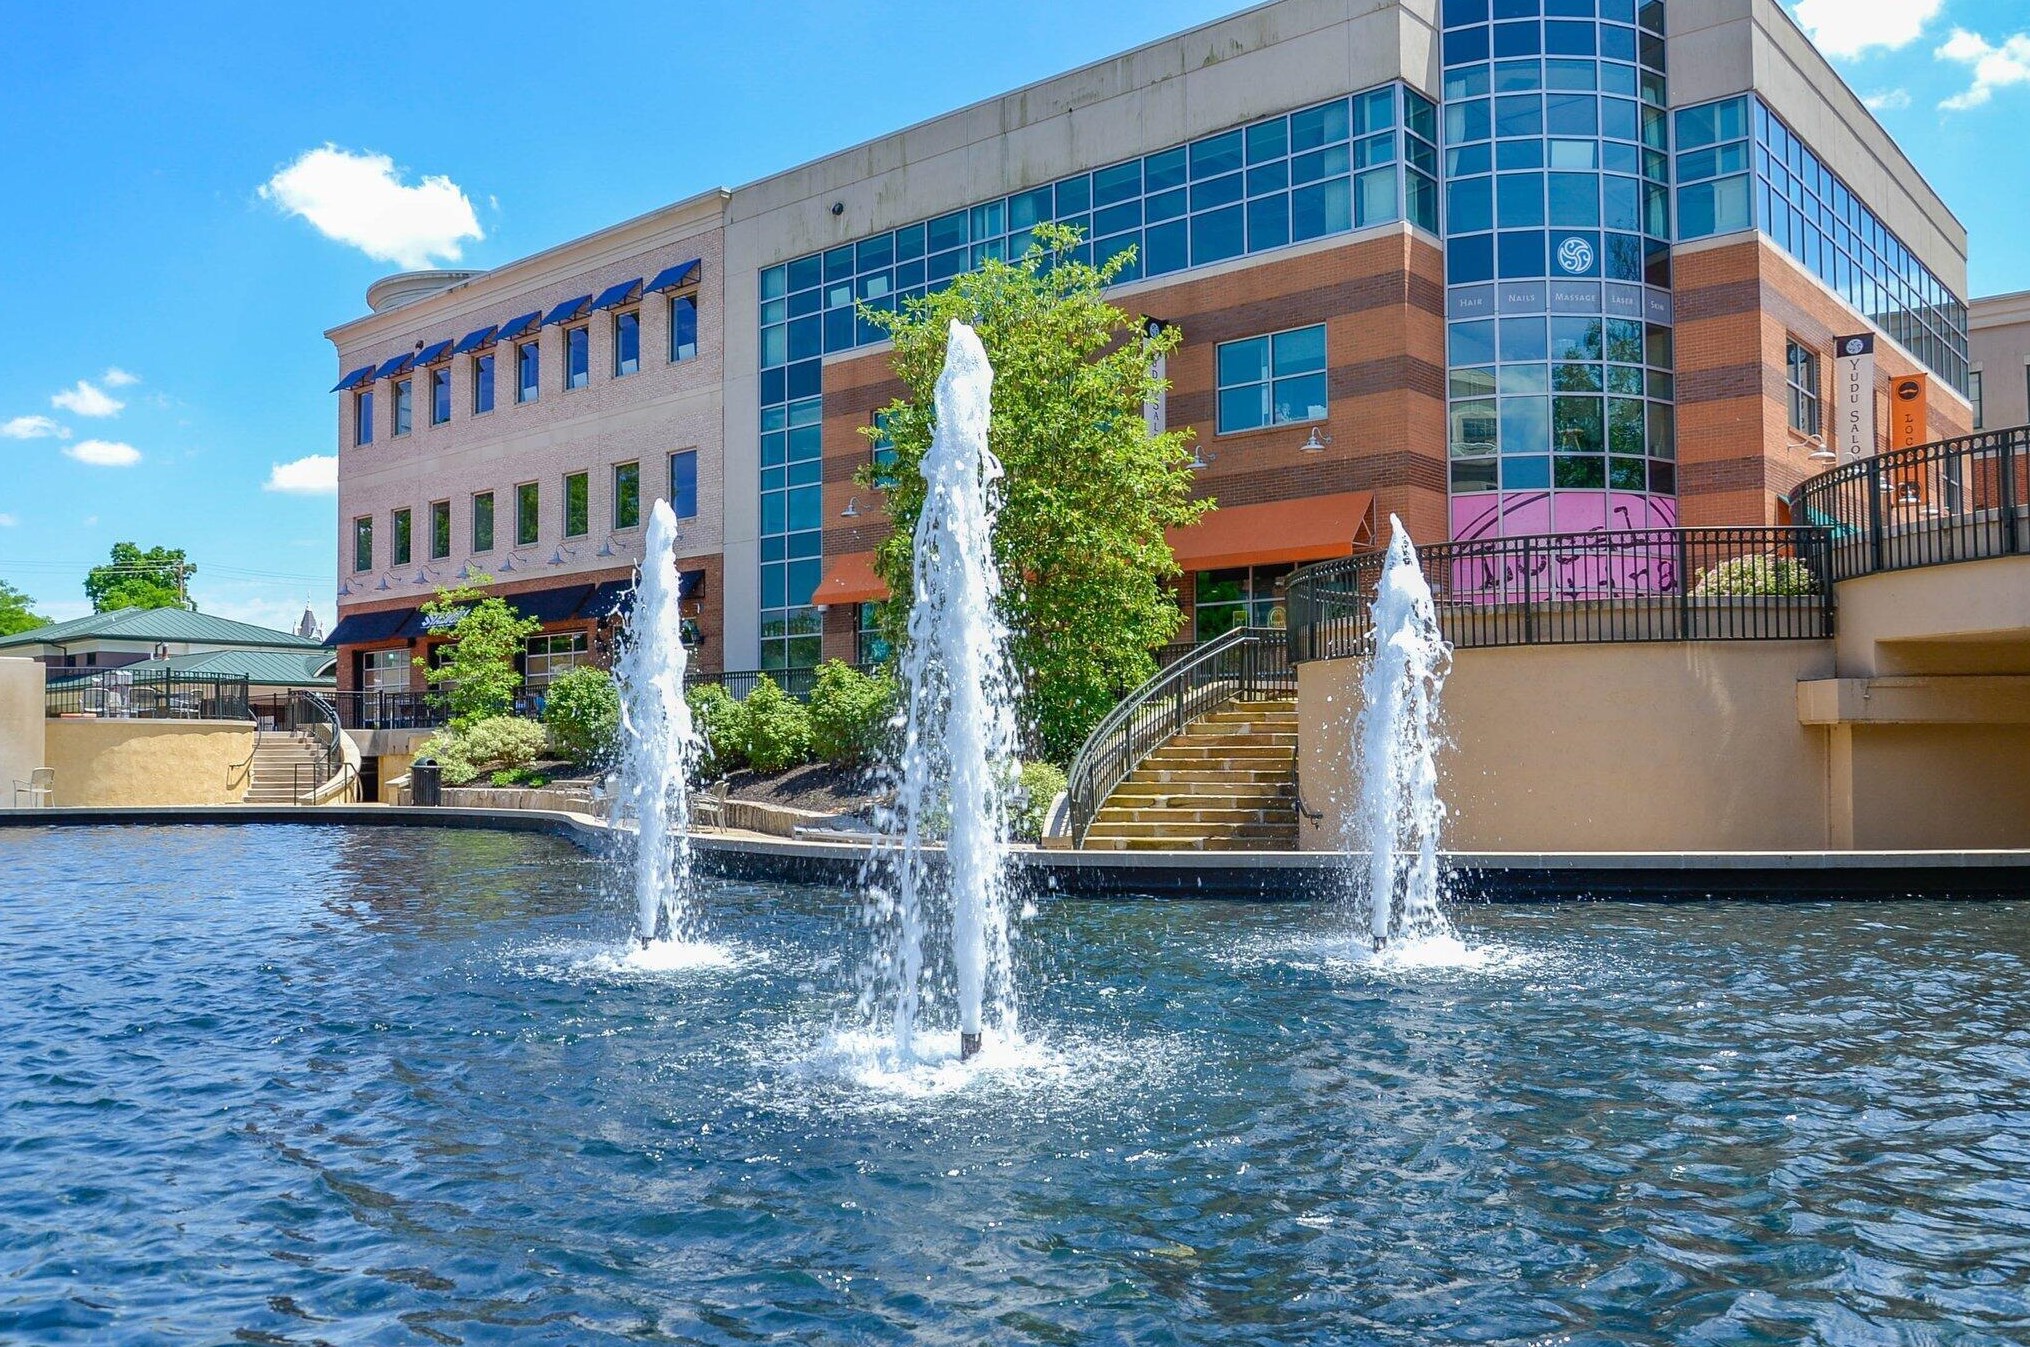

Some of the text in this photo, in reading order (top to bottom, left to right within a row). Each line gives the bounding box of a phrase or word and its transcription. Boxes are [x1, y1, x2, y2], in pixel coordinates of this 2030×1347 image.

[1460, 298, 1482, 308] HAIR
[1508, 294, 1535, 302] NAILS
[1555, 292, 1596, 302] MASSAGE
[1850, 358, 1860, 404] YUDU
